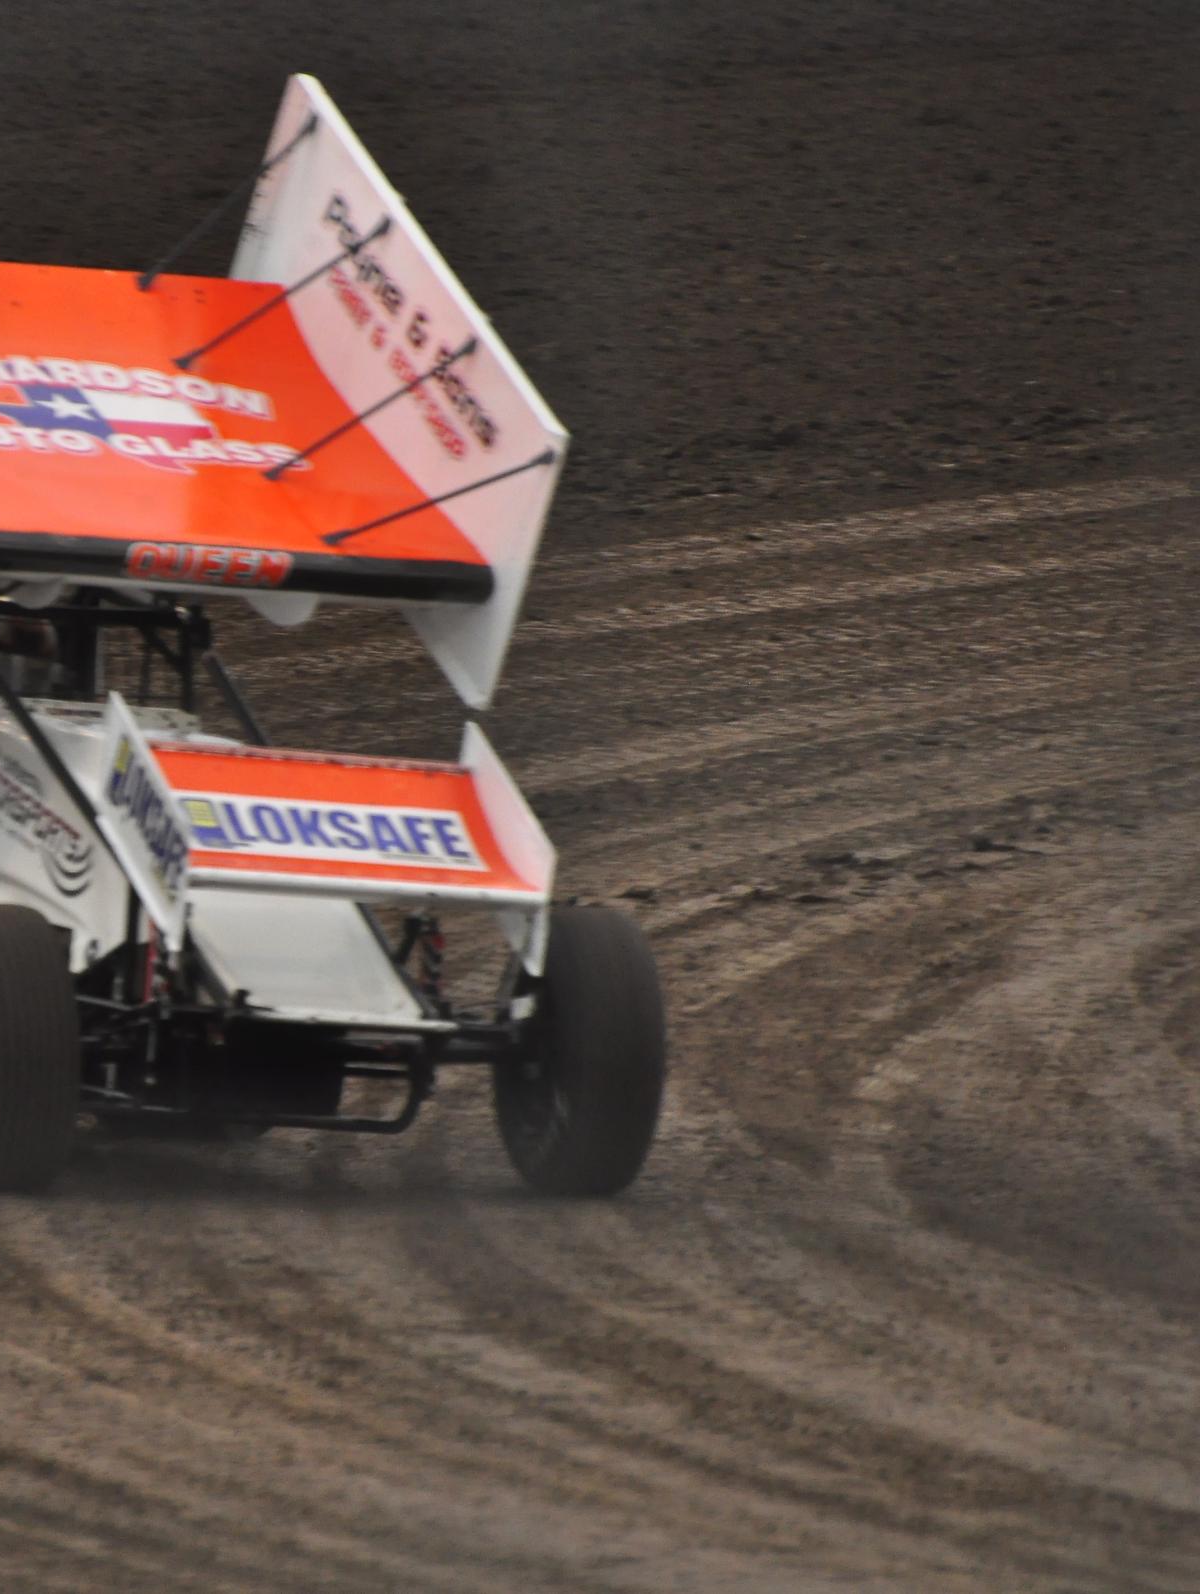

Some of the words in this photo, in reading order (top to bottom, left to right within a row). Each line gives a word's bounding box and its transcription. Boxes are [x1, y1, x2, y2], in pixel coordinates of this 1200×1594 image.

[106, 432, 313, 472] GLASS
[125, 541, 294, 588] QUEEN
[222, 802, 475, 858] LOKSAFE
